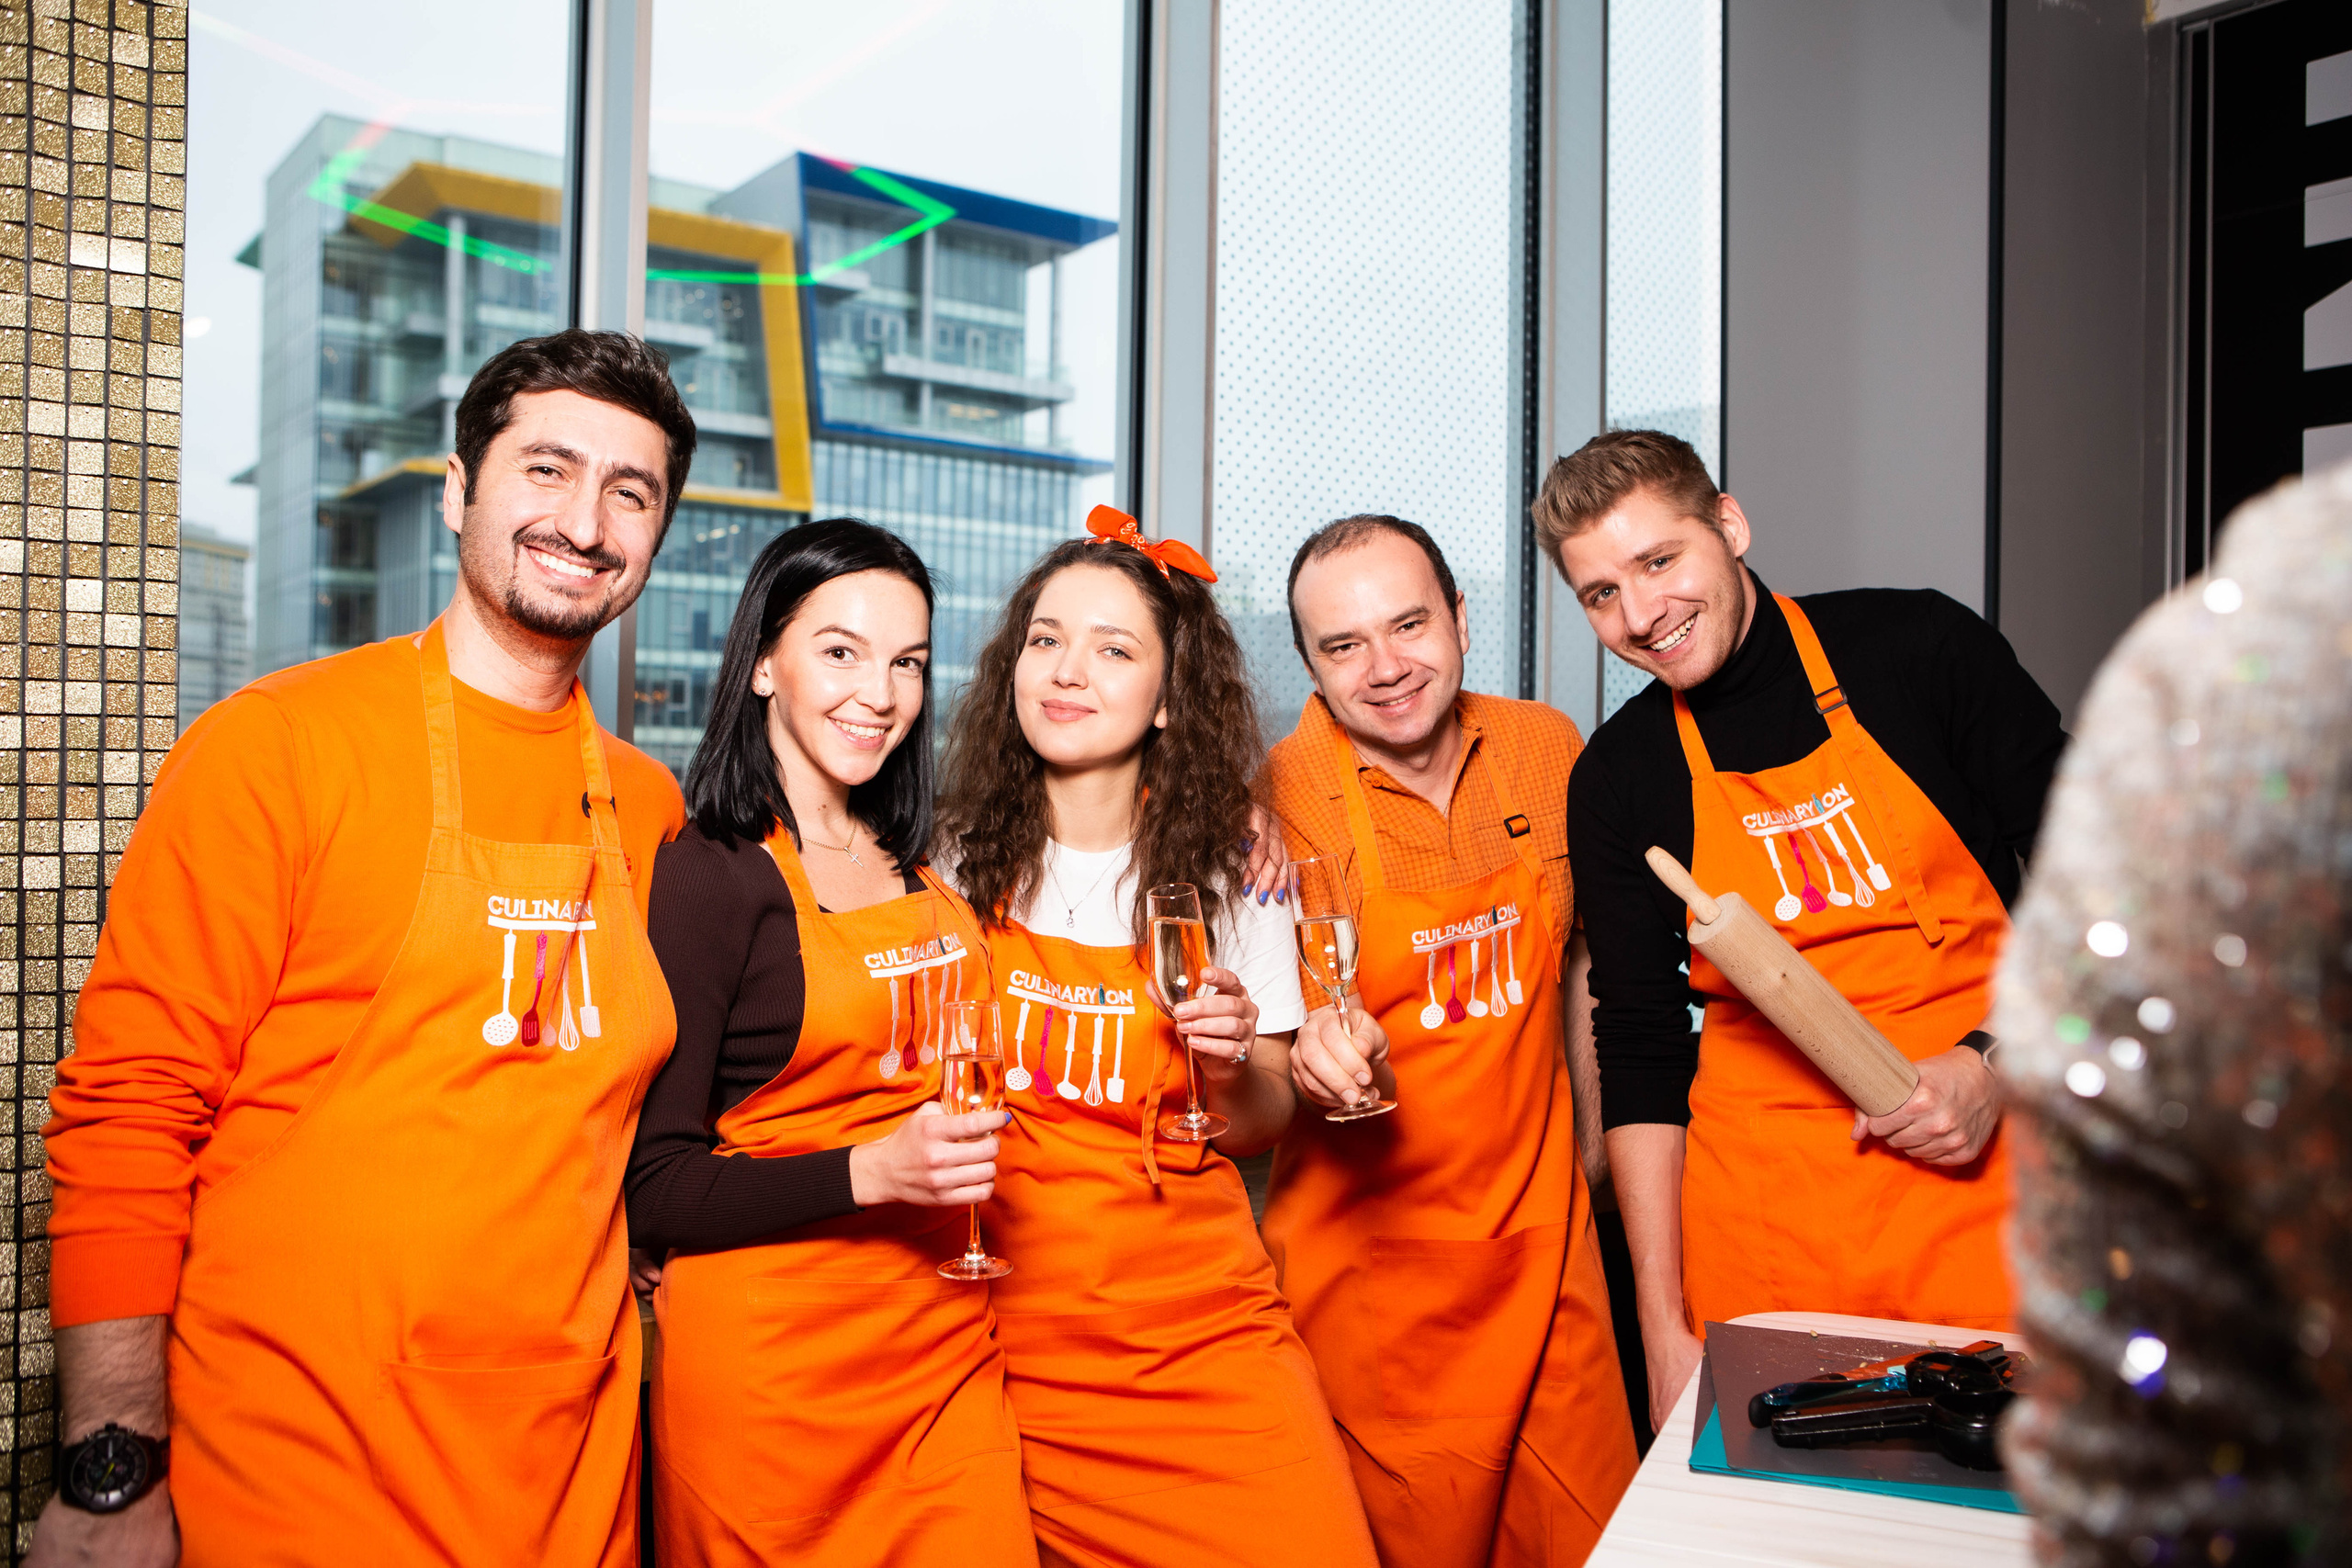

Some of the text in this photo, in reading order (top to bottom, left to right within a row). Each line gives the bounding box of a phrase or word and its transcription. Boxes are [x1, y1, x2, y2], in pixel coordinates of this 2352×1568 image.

[1411, 902, 1519, 945] CULINARYON
[864, 931, 963, 968] CULINARYON
[1010, 969, 1134, 1006] CULINARYON
